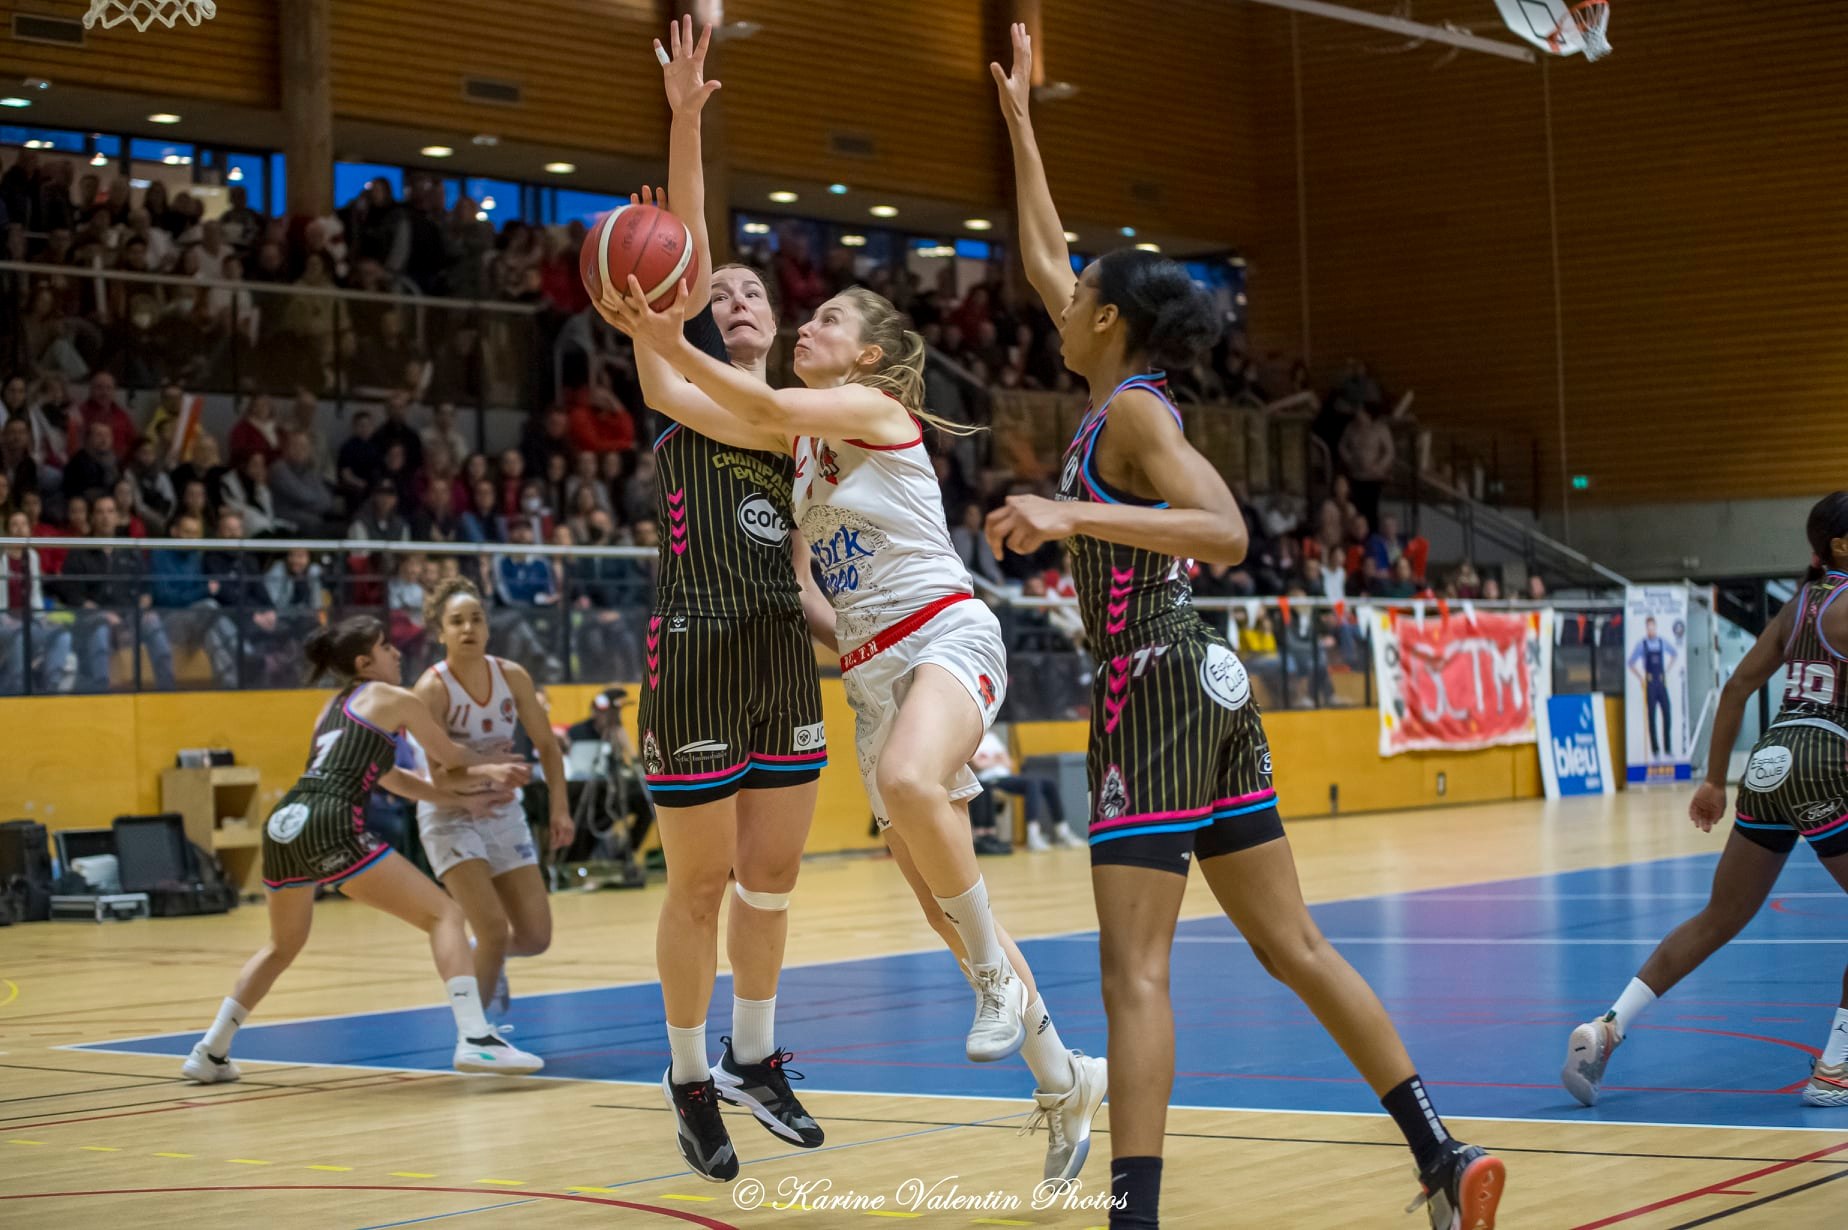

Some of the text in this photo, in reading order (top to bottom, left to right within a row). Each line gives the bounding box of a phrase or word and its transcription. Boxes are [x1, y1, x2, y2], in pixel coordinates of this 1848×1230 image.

[1552, 736, 1598, 777] bleu
[1751, 754, 1788, 770] ESPACE
[1807, 801, 1835, 820] Ford
